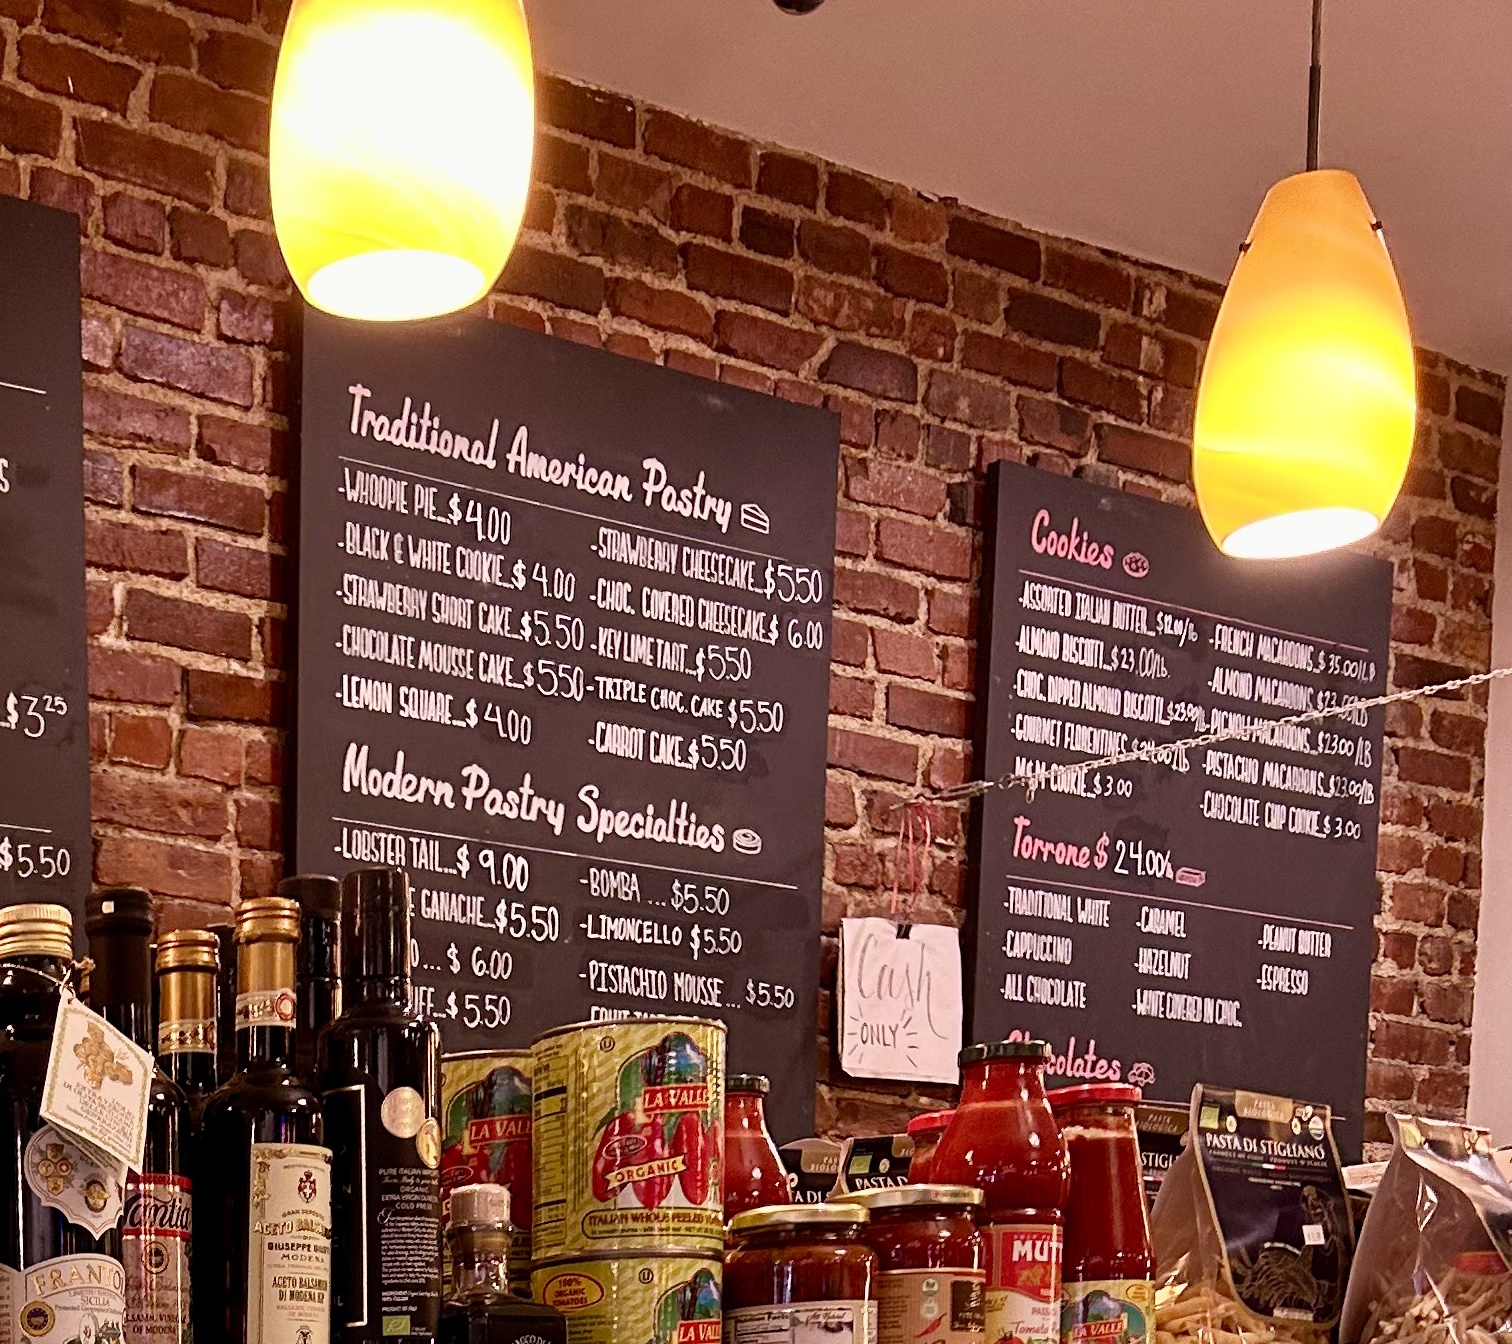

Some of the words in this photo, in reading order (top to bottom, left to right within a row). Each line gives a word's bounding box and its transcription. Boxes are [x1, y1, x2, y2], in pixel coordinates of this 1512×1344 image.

[348, 383, 499, 470] Traditional
[507, 426, 632, 502] American
[642, 458, 731, 534] Pastry
[1031, 508, 1115, 570] Cookies
[408, 536, 451, 575] WHITE
[431, 589, 475, 630] SHORT
[643, 585, 693, 628] COVERED
[1075, 592, 1110, 625] ITALIAN
[418, 641, 475, 682] MOUSSE
[691, 696, 723, 719] CAKE
[342, 743, 456, 810] Modern
[461, 764, 564, 835] Pastry
[577, 784, 725, 854] Specialties
[1264, 802, 1286, 833] CHIP
[1013, 814, 1091, 871] Torrone
[1077, 897, 1111, 928] WHITE
[1299, 931, 1331, 958] BUTTER
[857, 933, 949, 1040] Cash
[1029, 977, 1086, 1010] CHOCOLATE
[860, 1022, 899, 1048] ONLY
[645, 1092, 663, 1108] LA
[1206, 1132, 1242, 1150] PASTA
[1244, 1138, 1257, 1152] DI
[1260, 1140, 1325, 1160] STIGLIANO
[616, 1161, 679, 1183] ORGANIC
[254, 1220, 294, 1235] ACETO
[589, 1214, 629, 1226] ITALIAN
[631, 1212, 669, 1224] WHOLE
[1091, 1320, 1122, 1335] VALLE
